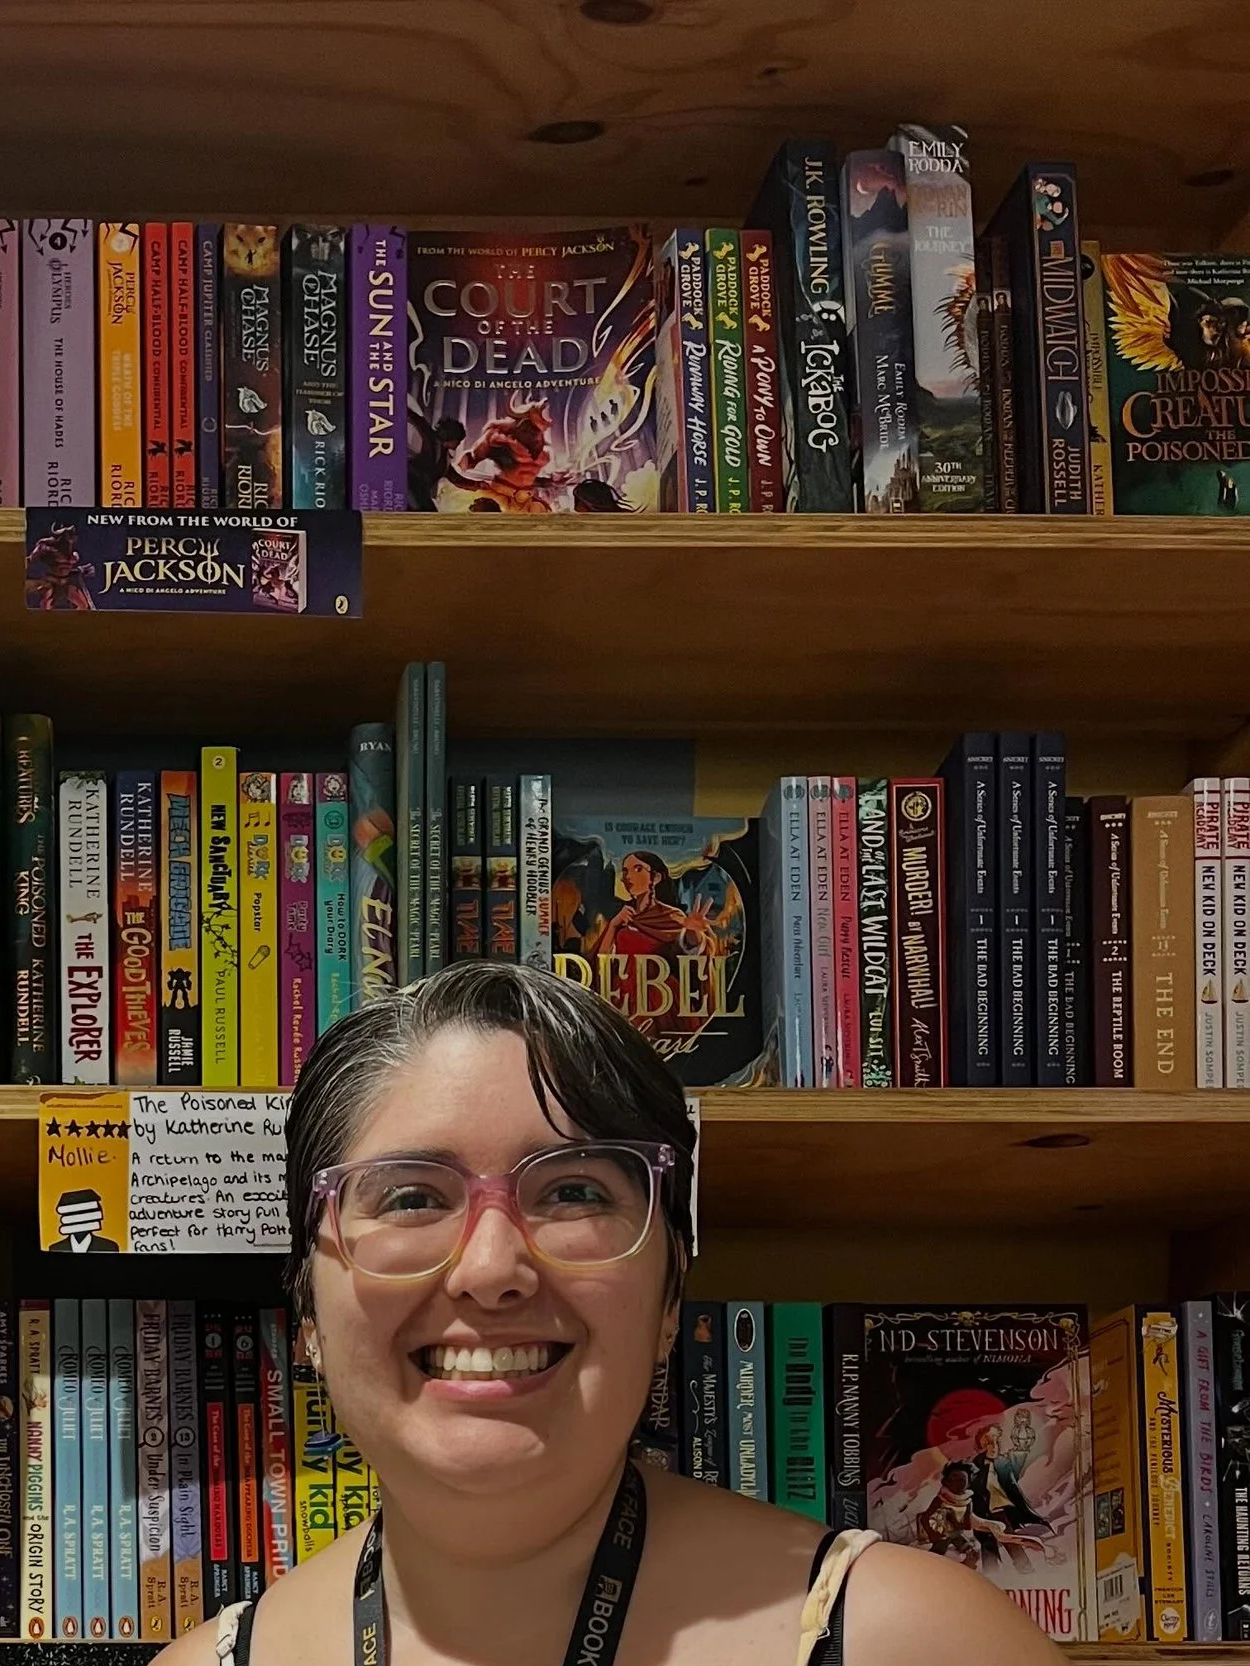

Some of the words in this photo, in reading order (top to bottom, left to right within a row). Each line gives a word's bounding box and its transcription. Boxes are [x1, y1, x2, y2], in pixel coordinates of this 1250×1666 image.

[909, 141, 964, 159] EMILY
[804, 157, 823, 190] J.K.
[909, 158, 964, 173] RODDA
[374, 240, 386, 267] THE
[416, 247, 446, 255] FROM
[447, 247, 466, 255] THE
[468, 247, 504, 256] WORLD
[506, 248, 519, 256] OF
[522, 246, 558, 257] PERCY
[561, 241, 615, 258] JACKSON
[806, 195, 830, 295] ROWLING
[495, 264, 535, 279] THE
[368, 271, 394, 336] SUN
[423, 277, 606, 317] COURT
[477, 321, 507, 334] OF
[512, 321, 553, 334] THE
[1042, 256, 1079, 381] MIDWATCH
[443, 337, 589, 373] DEAD
[368, 376, 395, 458] STAR
[1052, 438, 1066, 507] ROSSELL
[1067, 445, 1082, 501] JUDITH
[87, 515, 124, 526] NEW
[128, 515, 174, 527] FROM
[178, 516, 208, 526] THE
[211, 516, 273, 528] WORLD
[277, 516, 298, 528] OF
[125, 537, 220, 557] PERCY
[102, 558, 246, 592] JACKSON
[68, 798, 83, 888] RUNDELL
[85, 789, 101, 899] KATHERINE
[902, 846, 931, 918] MURDER!
[1201, 865, 1216, 895] NEW
[1201, 898, 1216, 921] KID
[74, 933, 94, 961] THE
[1202, 925, 1216, 943] ON
[976, 939, 987, 961] THE
[1202, 946, 1216, 977] DECK
[903, 931, 938, 1009] NARWHAL!
[976, 965, 987, 987] BAD
[1156, 972, 1173, 1016] THE
[67, 965, 102, 1064] EXPLORER
[976, 991, 987, 1056] BEGINNING
[1156, 1025, 1174, 1075] END
[134, 1096, 167, 1115] The
[180, 1092, 256, 1113] Poisoned
[133, 1119, 156, 1144] by
[166, 1117, 255, 1136] Katherine
[150, 1154, 199, 1165] return
[230, 1151, 255, 1164] the
[131, 1172, 217, 1192] Archipelago
[224, 1173, 248, 1185] and
[216, 1190, 235, 1203] An
[129, 1208, 205, 1220] adventure
[213, 1208, 251, 1224] story
[257, 1206, 280, 1219] full
[130, 1224, 181, 1241] perfect
[187, 1224, 210, 1238] for
[217, 1224, 255, 1243] Harry
[134, 1239, 177, 1253] fans!
[926, 1330, 1058, 1352] STEVENSON
